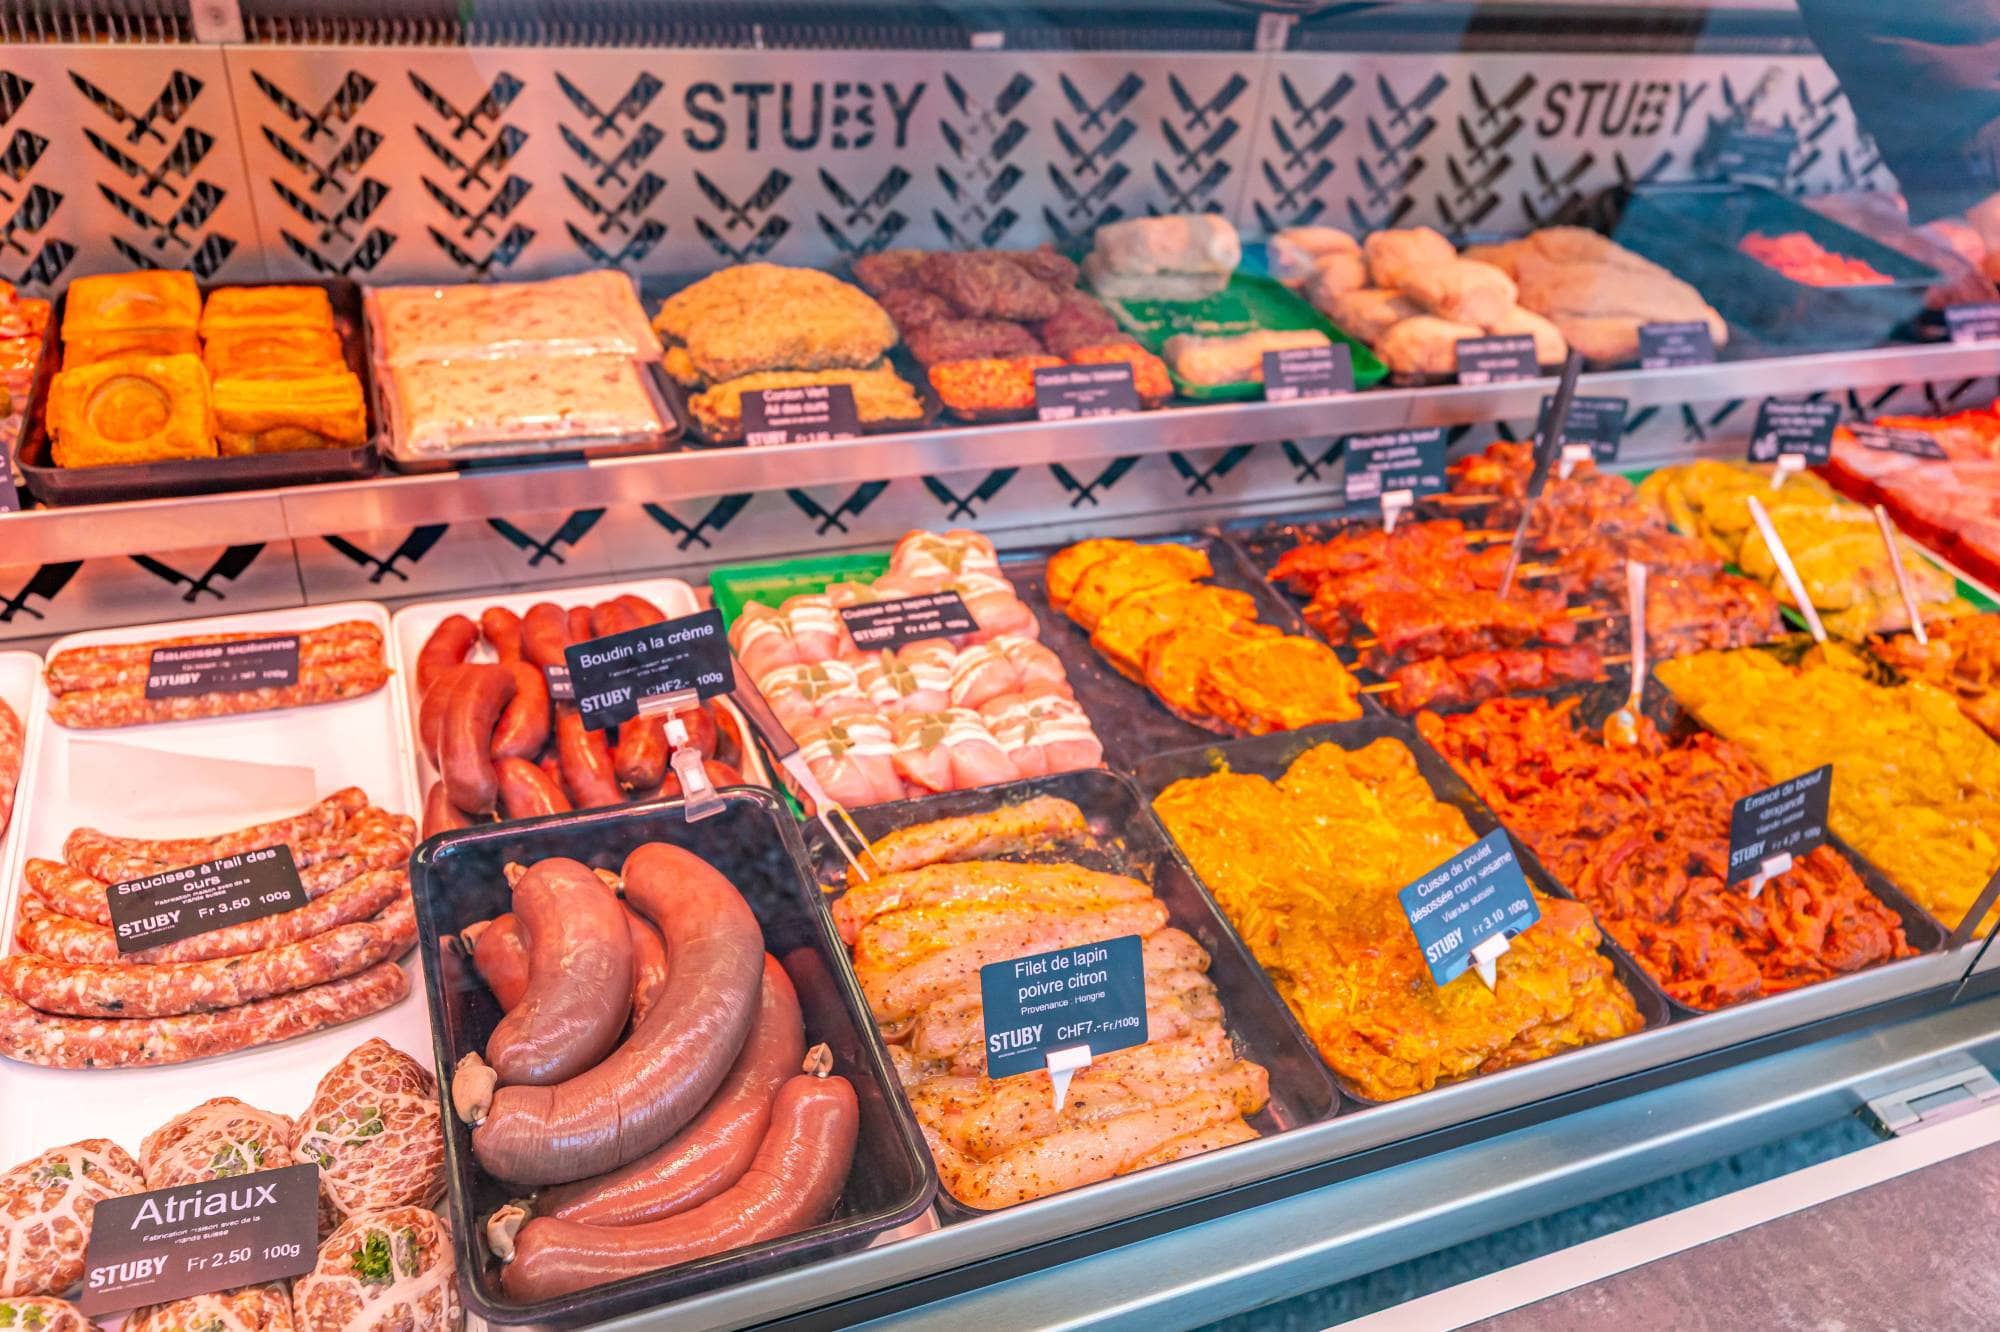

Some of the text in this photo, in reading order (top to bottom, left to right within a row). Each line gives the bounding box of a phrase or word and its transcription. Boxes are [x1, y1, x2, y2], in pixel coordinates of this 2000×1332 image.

[683, 82, 927, 151] STUBY
[1536, 80, 1707, 138] STUBY
[580, 646, 634, 668] Boudin
[637, 640, 648, 653] à
[651, 637, 664, 650] la
[667, 624, 715, 645] crème
[853, 625, 895, 642] STUBY
[153, 648, 223, 663] Saucisse
[149, 672, 201, 688] STUBY
[580, 687, 632, 714] STUBY
[696, 671, 724, 686] 100g
[118, 868, 196, 895] Saucisse
[200, 864, 211, 876] à
[246, 848, 278, 864] des
[1417, 843, 1492, 897] Cuisse de poulet
[1731, 840, 1766, 867] STUBY
[183, 875, 222, 892] ours
[118, 910, 181, 937] STUBY
[198, 907, 215, 919] Fr
[218, 897, 252, 914] 3.50
[259, 889, 292, 905] 100g
[1426, 927, 1464, 964] STUBY
[1485, 908, 1505, 930] 3.10
[1507, 898, 1529, 916] 100g
[1015, 947, 1108, 979] Filet de lapin
[1019, 969, 1108, 1003] poivre citron
[1021, 998, 1069, 1016] Provenance
[1074, 990, 1106, 1004] Hongrie
[989, 1024, 1044, 1053] STUBY
[1057, 1020, 1102, 1041] CHF7.-
[130, 1183, 278, 1231] Atriaux
[143, 1229, 188, 1243] Fabrication
[221, 1218, 240, 1229] avec
[240, 1216, 251, 1226] de
[88, 1255, 169, 1288] STUBY
[187, 1257, 208, 1272] Fr
[212, 1247, 252, 1269] 2.50
[263, 1243, 301, 1260] 100g
